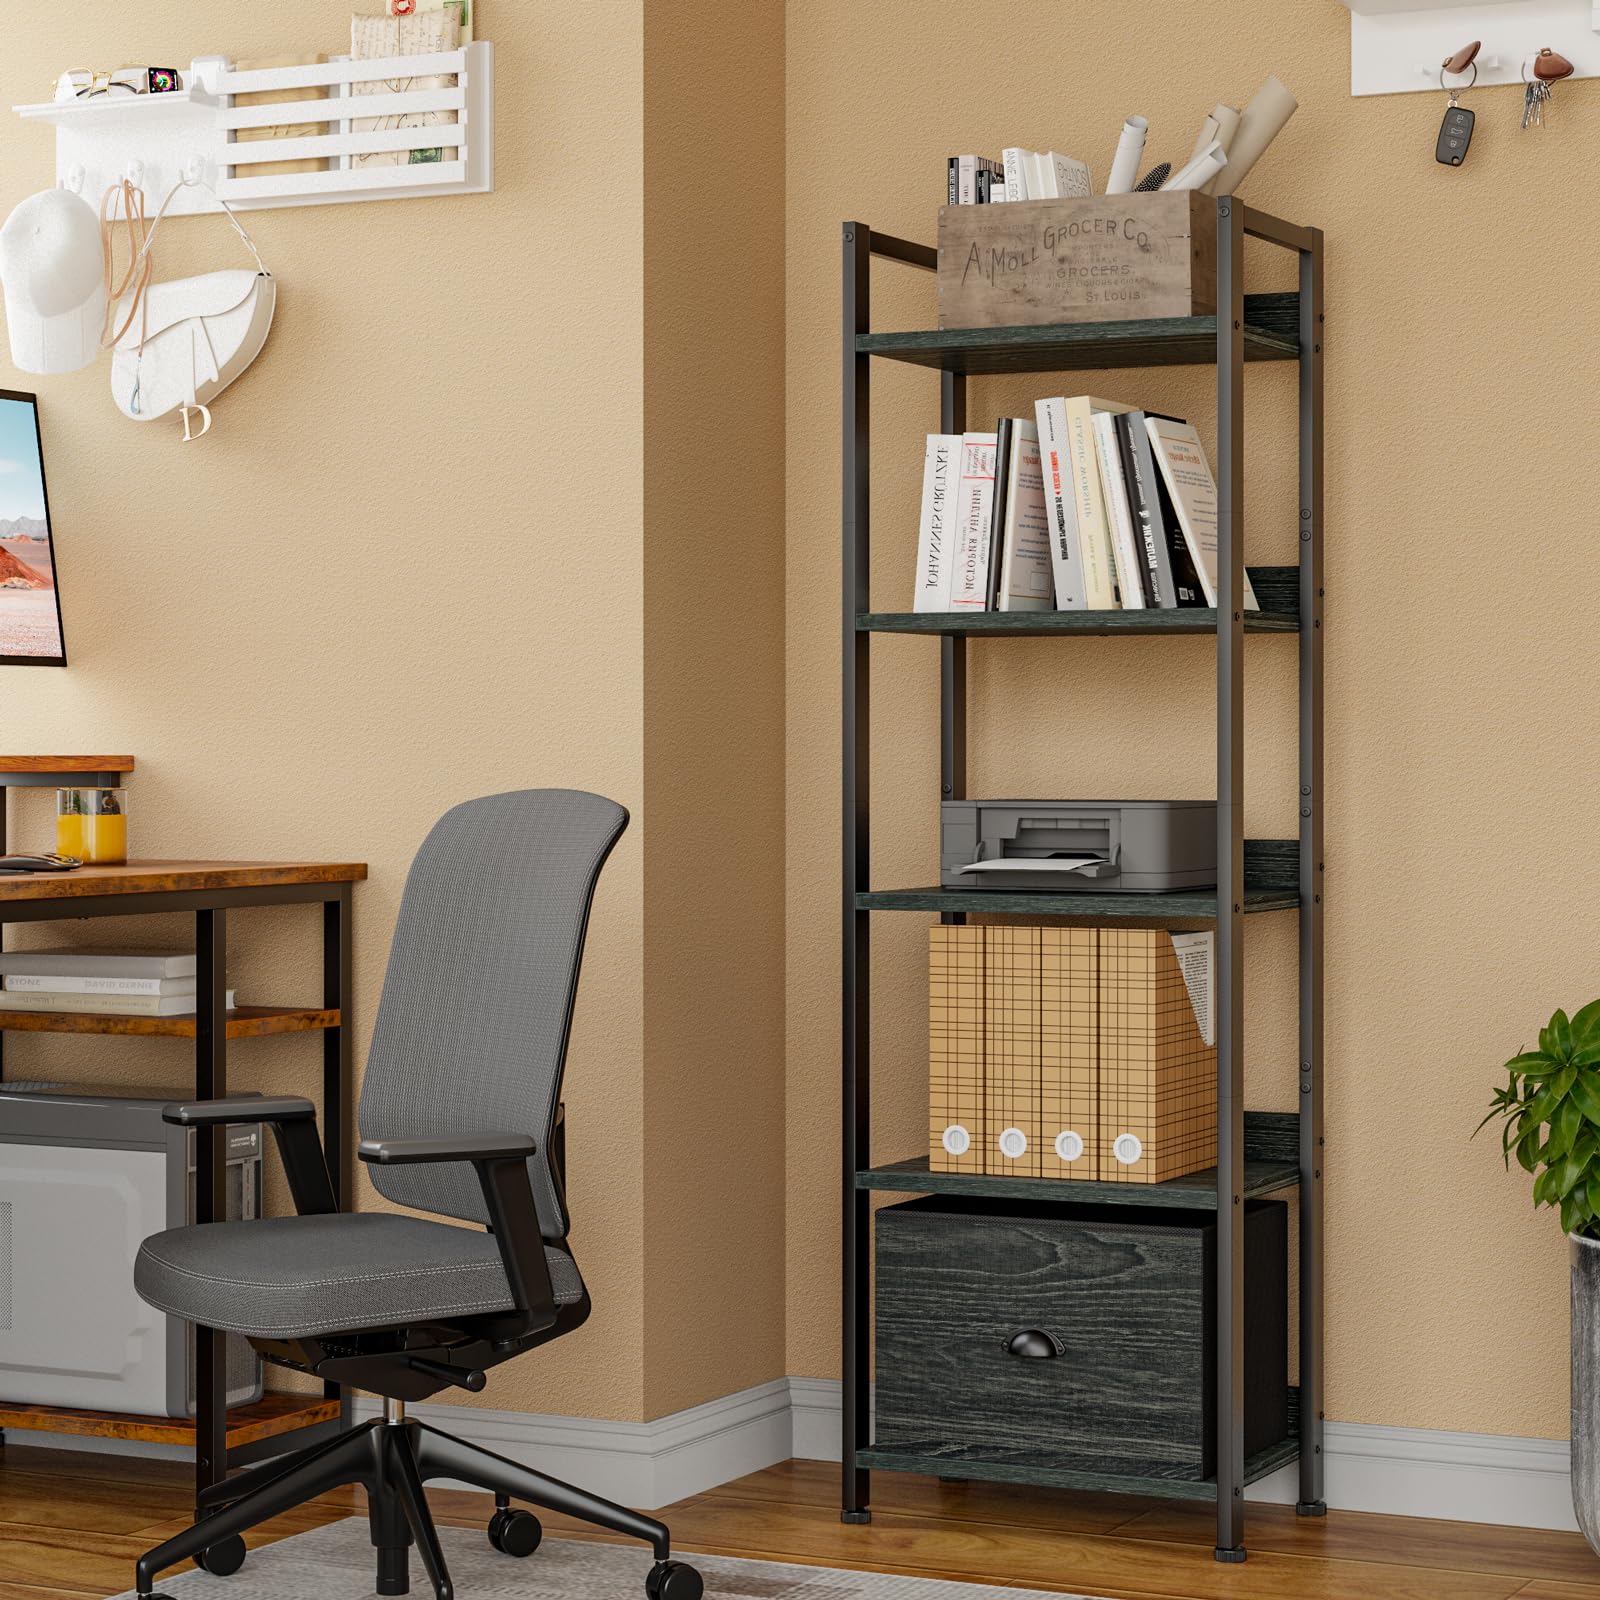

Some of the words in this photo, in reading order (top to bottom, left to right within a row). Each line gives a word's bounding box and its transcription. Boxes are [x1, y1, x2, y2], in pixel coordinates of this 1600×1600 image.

[991, 247, 1040, 287] MOLL
[1043, 218, 1117, 257] GROCER
[1056, 264, 1131, 279] GROCERS
[1104, 289, 1141, 302] LOUIS
